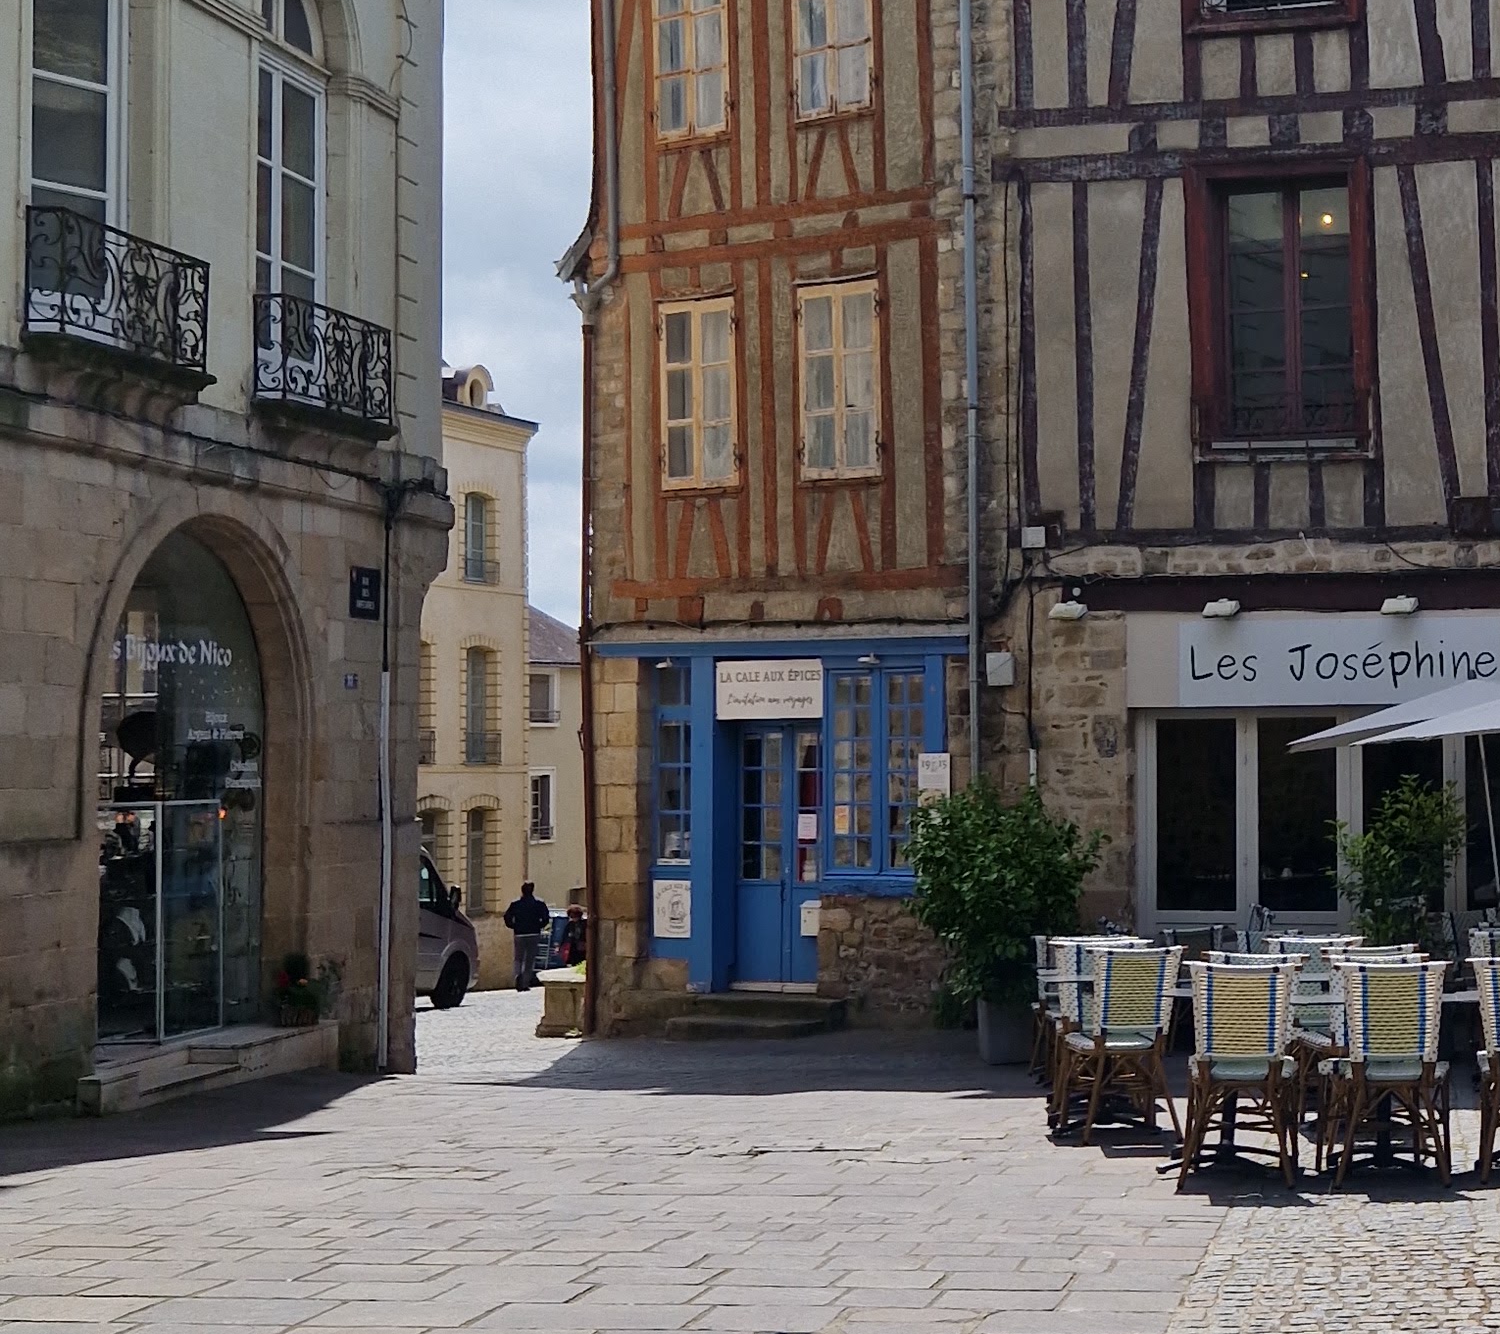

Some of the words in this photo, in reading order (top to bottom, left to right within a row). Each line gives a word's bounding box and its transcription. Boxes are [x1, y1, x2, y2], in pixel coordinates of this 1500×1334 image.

[125, 634, 175, 670] Bijoux
[178, 640, 196, 664] de
[199, 639, 232, 667] Nico
[1190, 644, 1258, 682] Les
[1288, 640, 1498, 689] Joséphine
[720, 672, 733, 683] LA
[735, 671, 760, 683] CALE
[763, 670, 785, 682] AUX
[788, 668, 821, 682] ÉPICES
